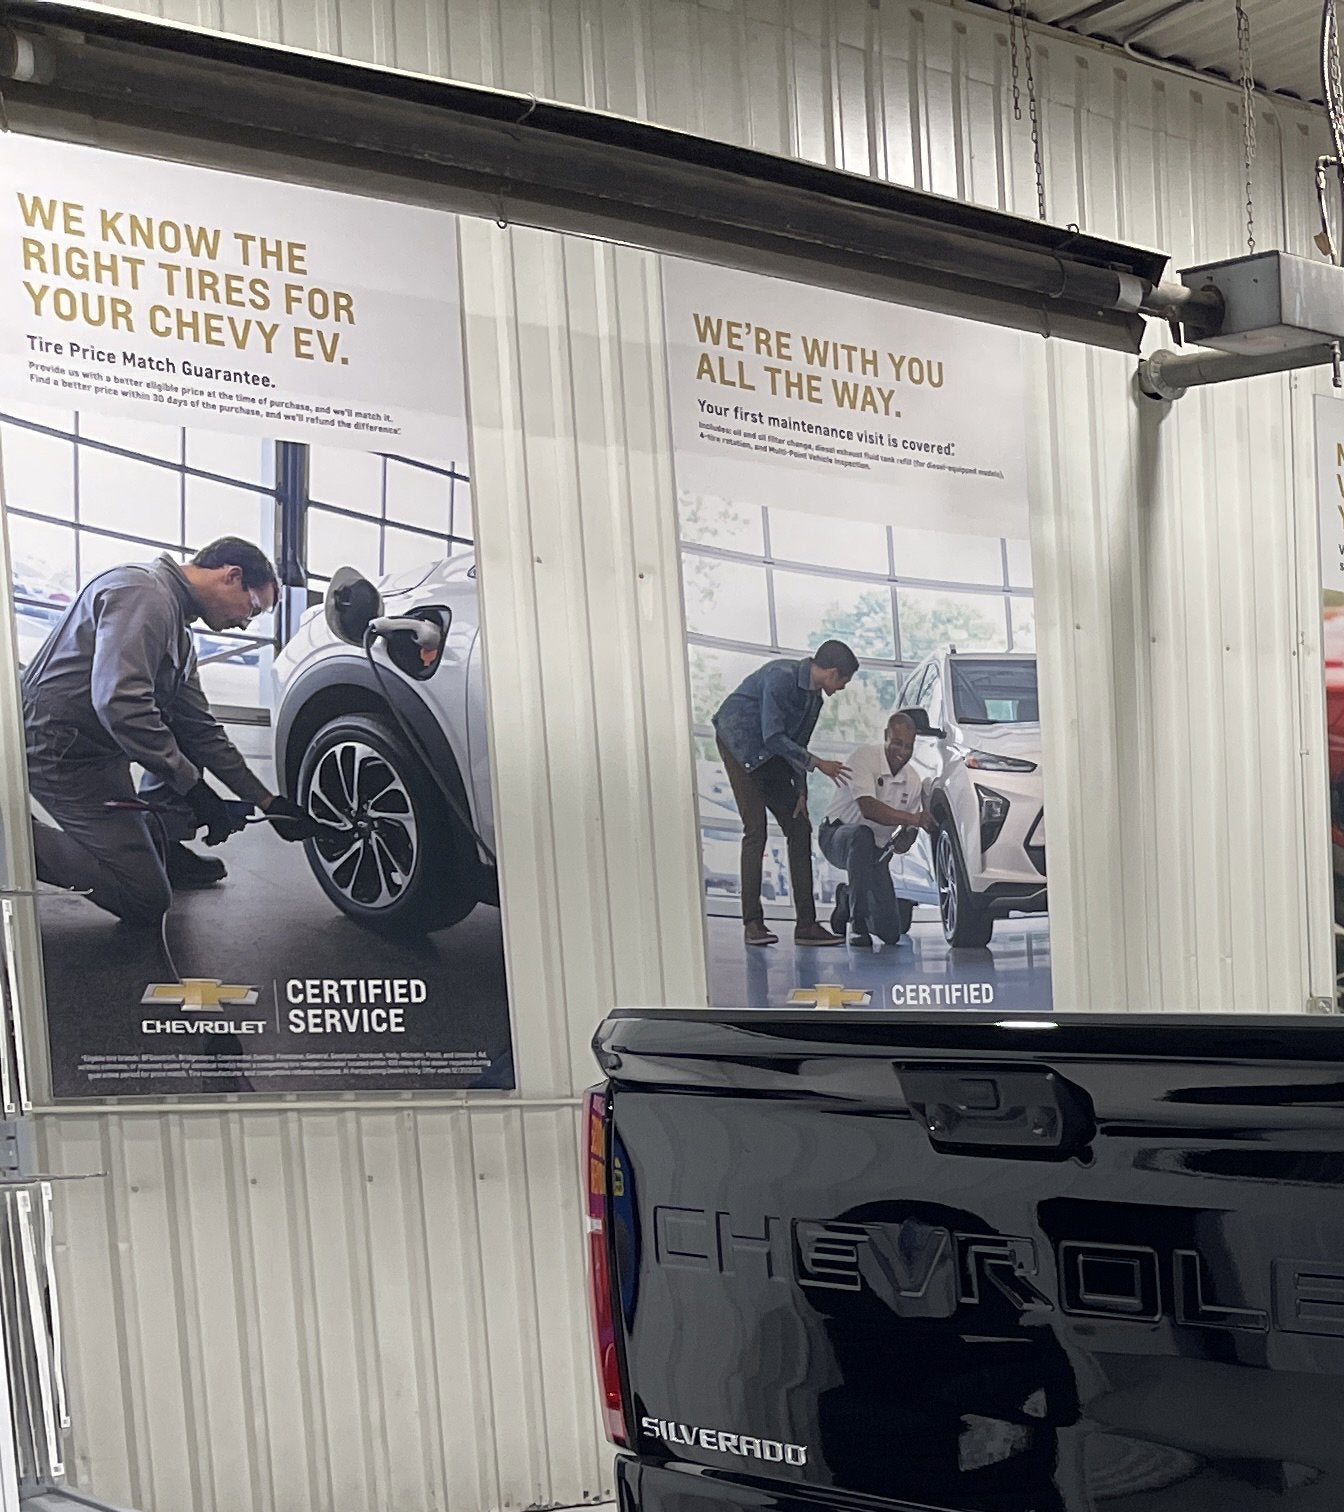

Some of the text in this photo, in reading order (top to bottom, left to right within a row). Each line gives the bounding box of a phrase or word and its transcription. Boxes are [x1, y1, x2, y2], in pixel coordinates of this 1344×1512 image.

[16, 192, 307, 275] WE KNOW THE
[21, 238, 355, 325] RIGHT TIRES FOR
[22, 281, 349, 365] YOUR CHEVY EV.
[26, 334, 276, 389] Tire Price Match Guarantee.
[692, 313, 945, 388] WE'RE WITH YOU
[28, 360, 66, 375] Provide
[114, 375, 143, 388] better
[182, 386, 205, 397] price
[29, 373, 51, 385] Find
[61, 378, 91, 391] better
[94, 385, 119, 396] price
[696, 352, 902, 418] ALL THE WAY.
[698, 399, 730, 418] Your
[734, 405, 765, 425] first
[768, 414, 854, 441] maintenance
[857, 430, 884, 446] visit
[888, 434, 898, 448] is
[285, 979, 427, 1005] CERTIFIED
[892, 983, 994, 1005] CERTIFIED
[141, 1020, 267, 1034] CHEVROLET
[288, 1009, 406, 1033] SERVICE
[641, 1415, 808, 1468] SILVERADO
